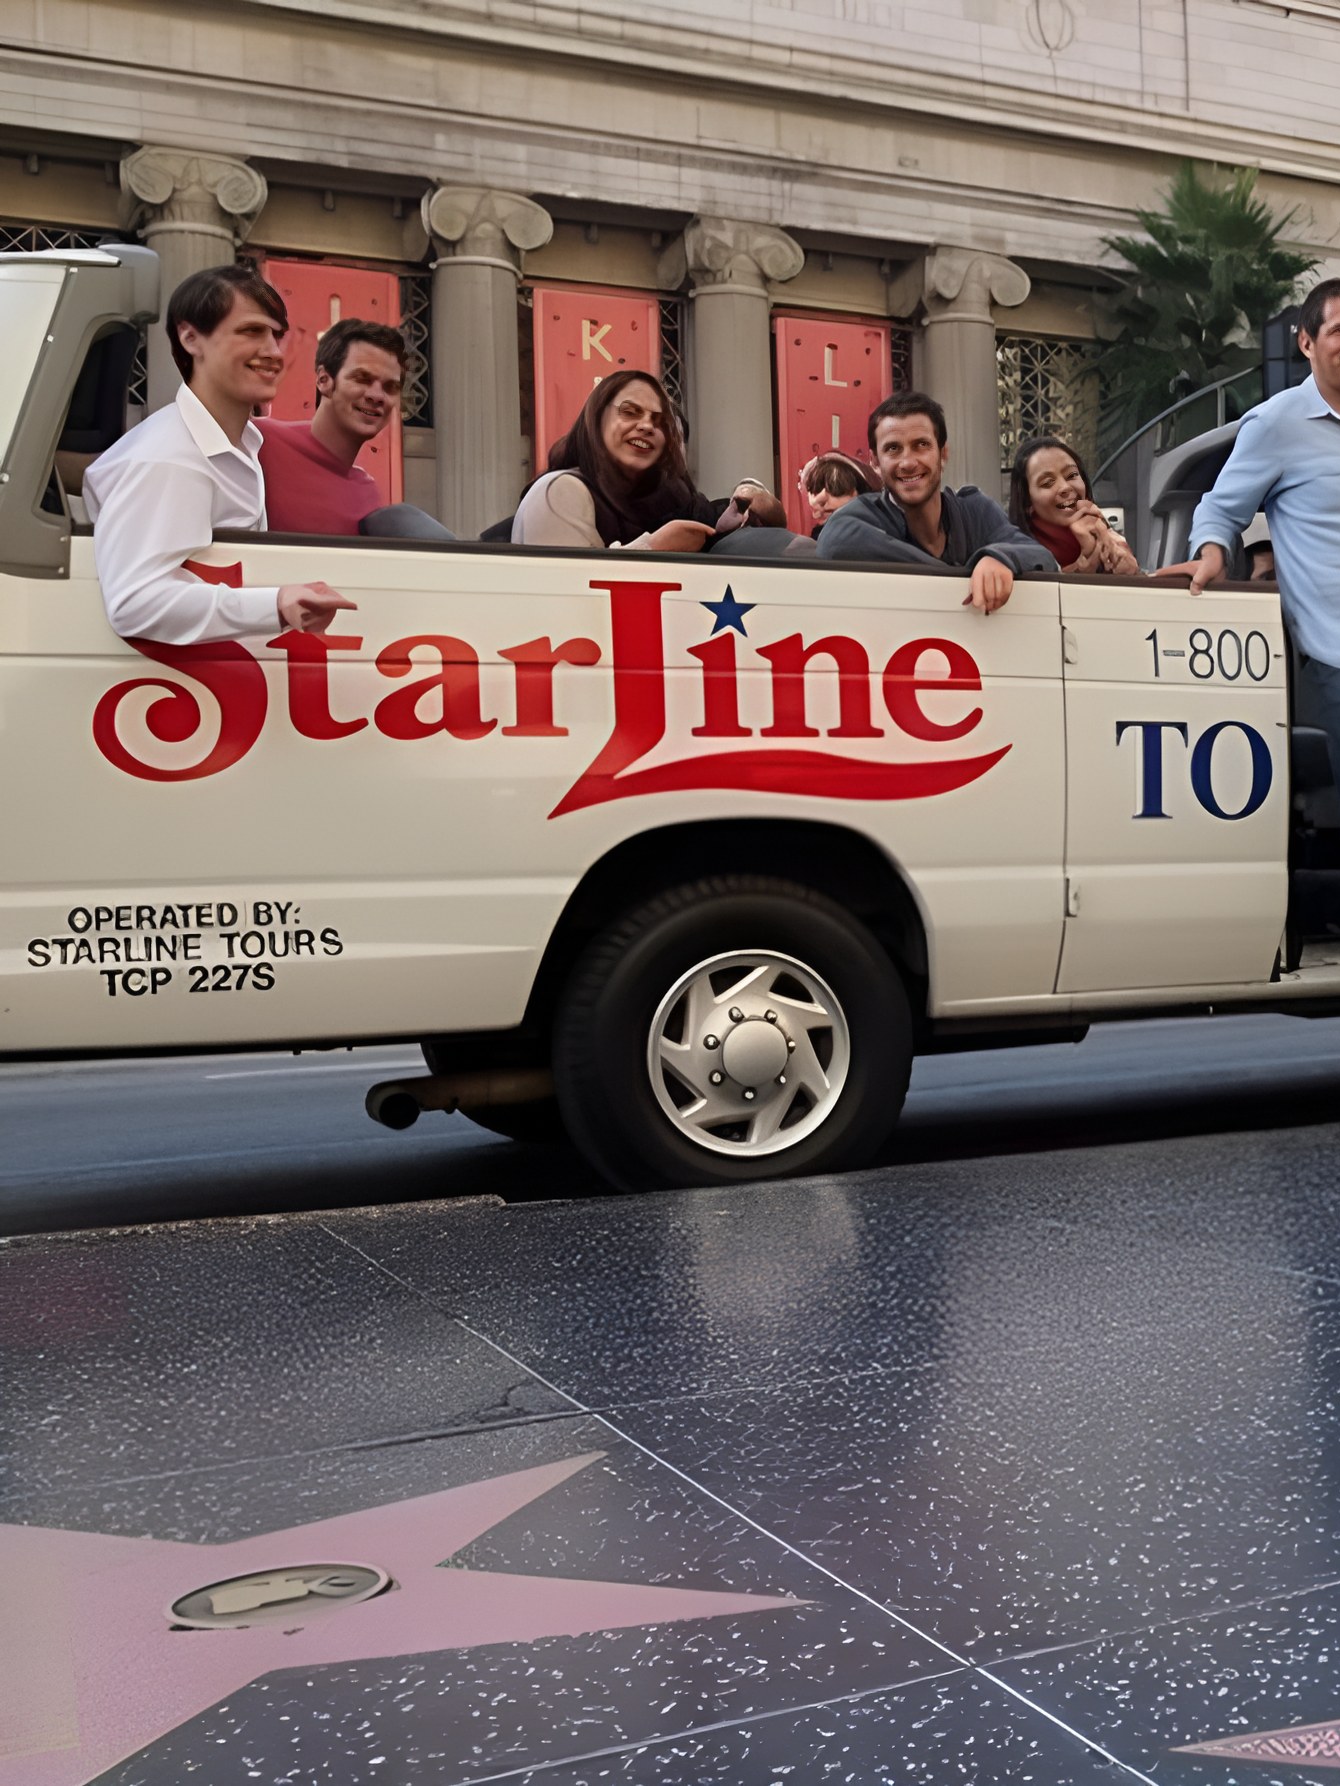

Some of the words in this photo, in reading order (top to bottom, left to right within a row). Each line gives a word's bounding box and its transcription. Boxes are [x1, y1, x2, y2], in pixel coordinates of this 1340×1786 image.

[92, 559, 1013, 820] StarLine
[1115, 720, 1287, 821] TO
[67, 902, 239, 934] OPERATED
[253, 901, 302, 926] BY:
[27, 933, 203, 967] STARLINE
[219, 927, 344, 958] TOURS
[100, 967, 173, 997] TCP
[188, 962, 276, 993] 227S
